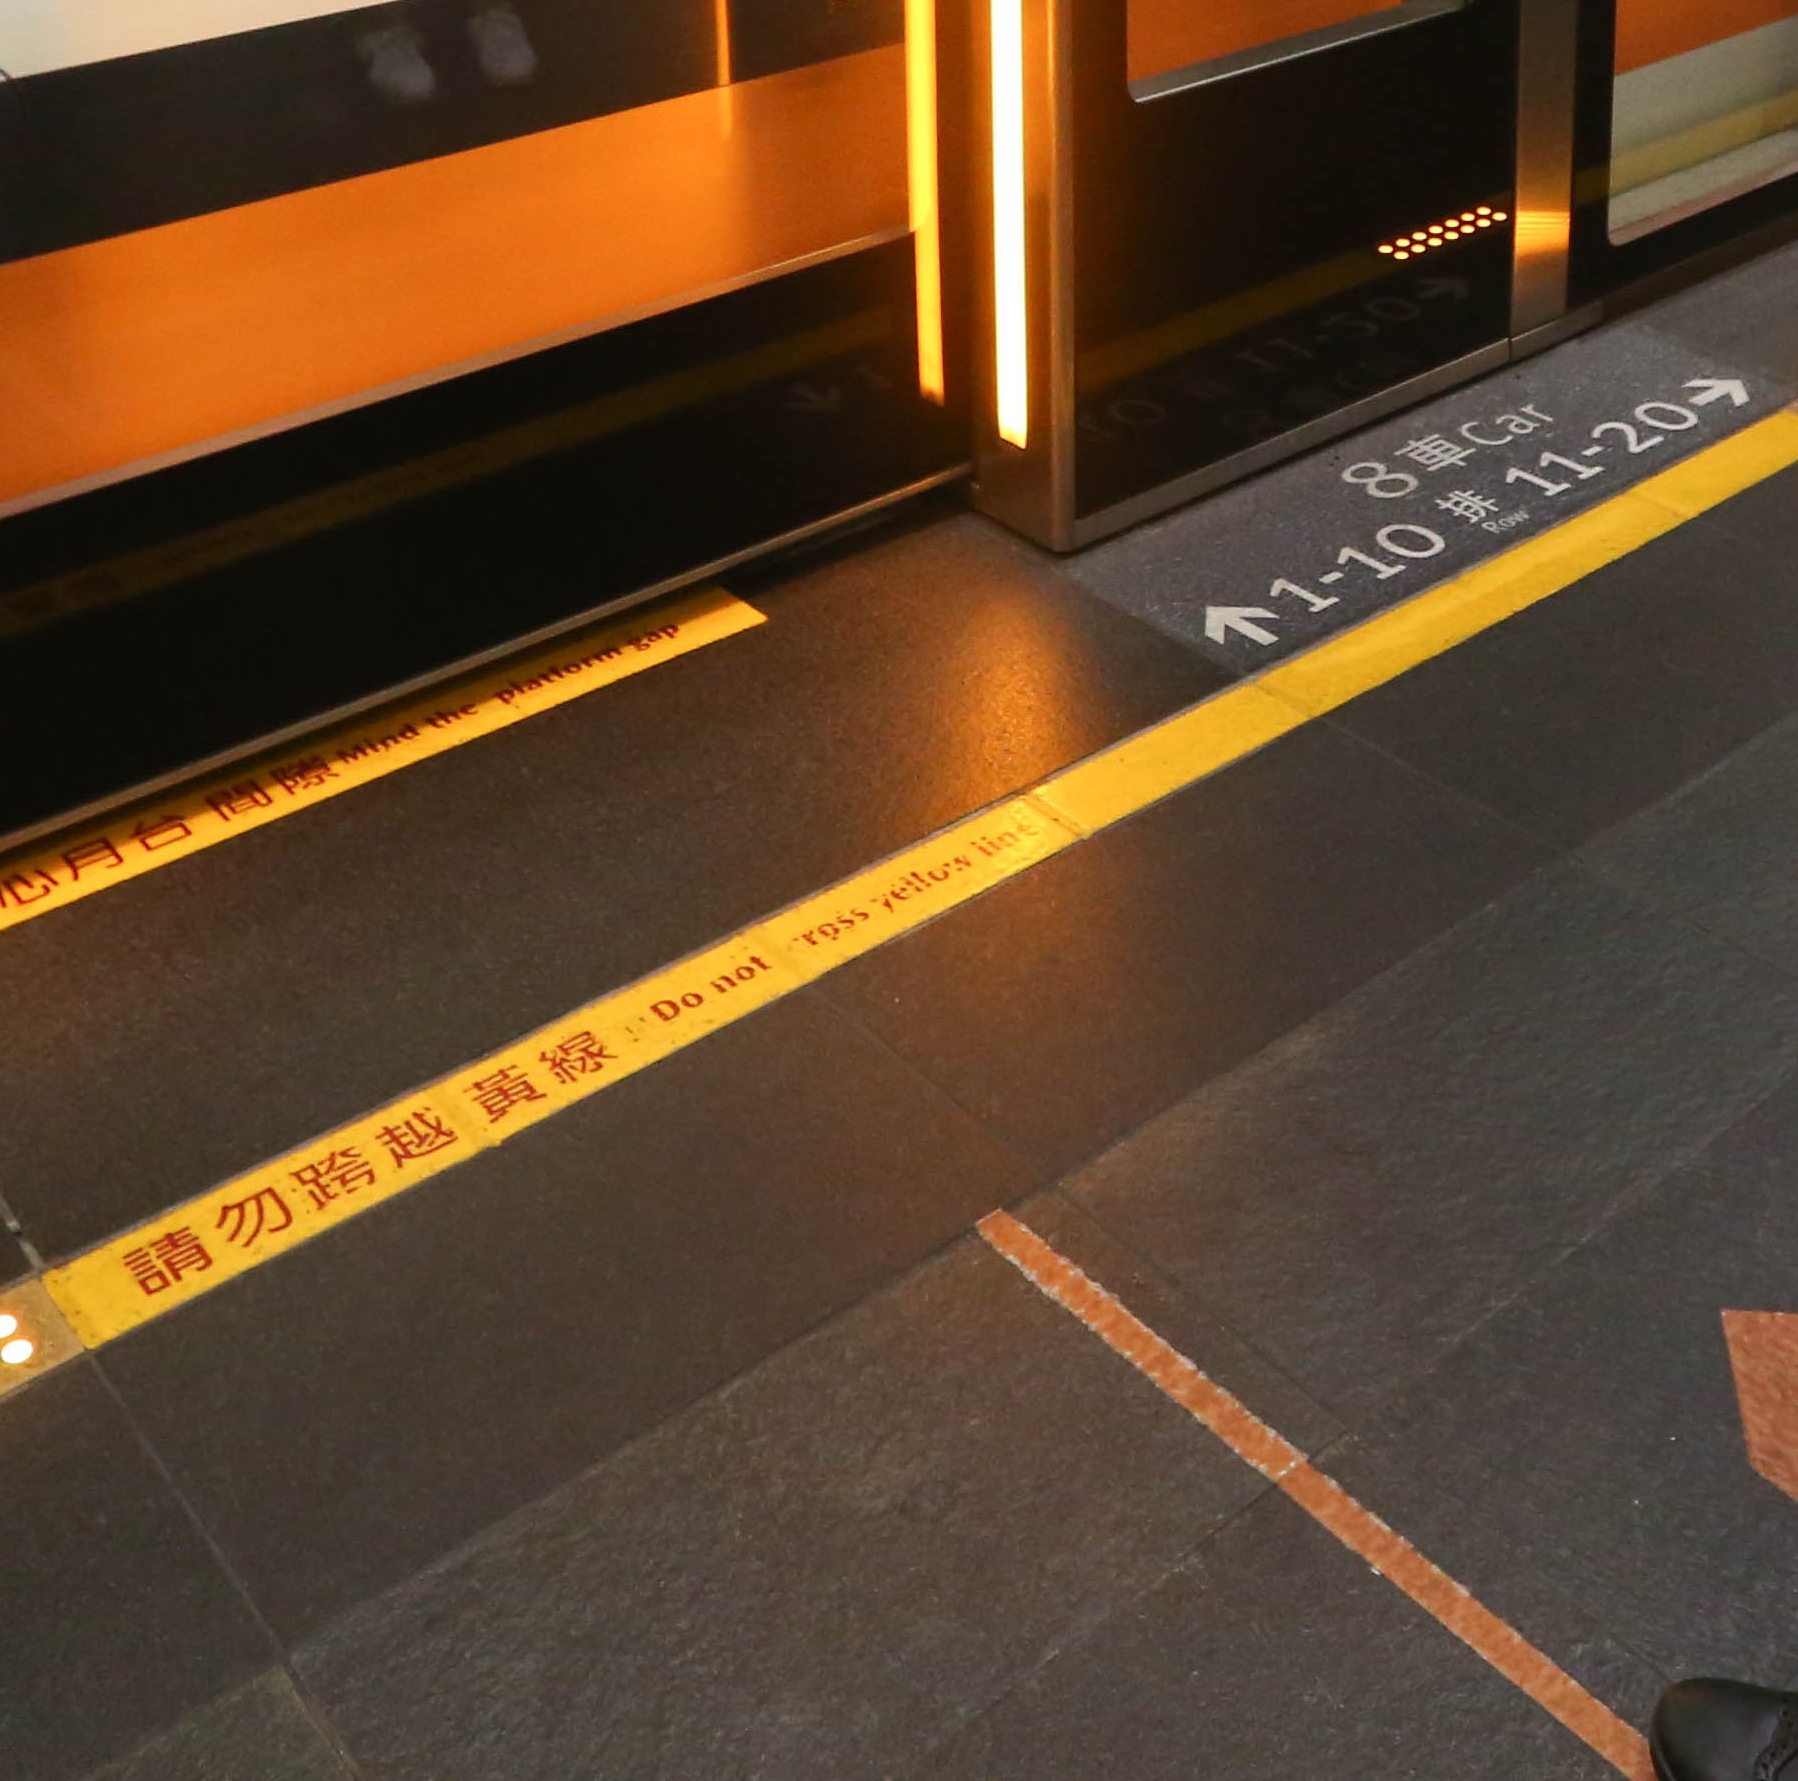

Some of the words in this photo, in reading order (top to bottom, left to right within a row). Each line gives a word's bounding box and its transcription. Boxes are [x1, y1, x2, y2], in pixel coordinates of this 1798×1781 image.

[1270, 523, 1446, 614] 1-10
[1436, 490, 1502, 524] 排
[1506, 400, 1700, 497] 11-20
[1482, 509, 1531, 535] Row
[336, 724, 421, 764] Mind
[426, 702, 479, 730] the
[495, 646, 625, 705] platform
[627, 622, 682, 652] gap
[123, 1028, 621, 1297] 請勿跨越黃線
[649, 991, 704, 1022] Do
[710, 955, 774, 993] not
